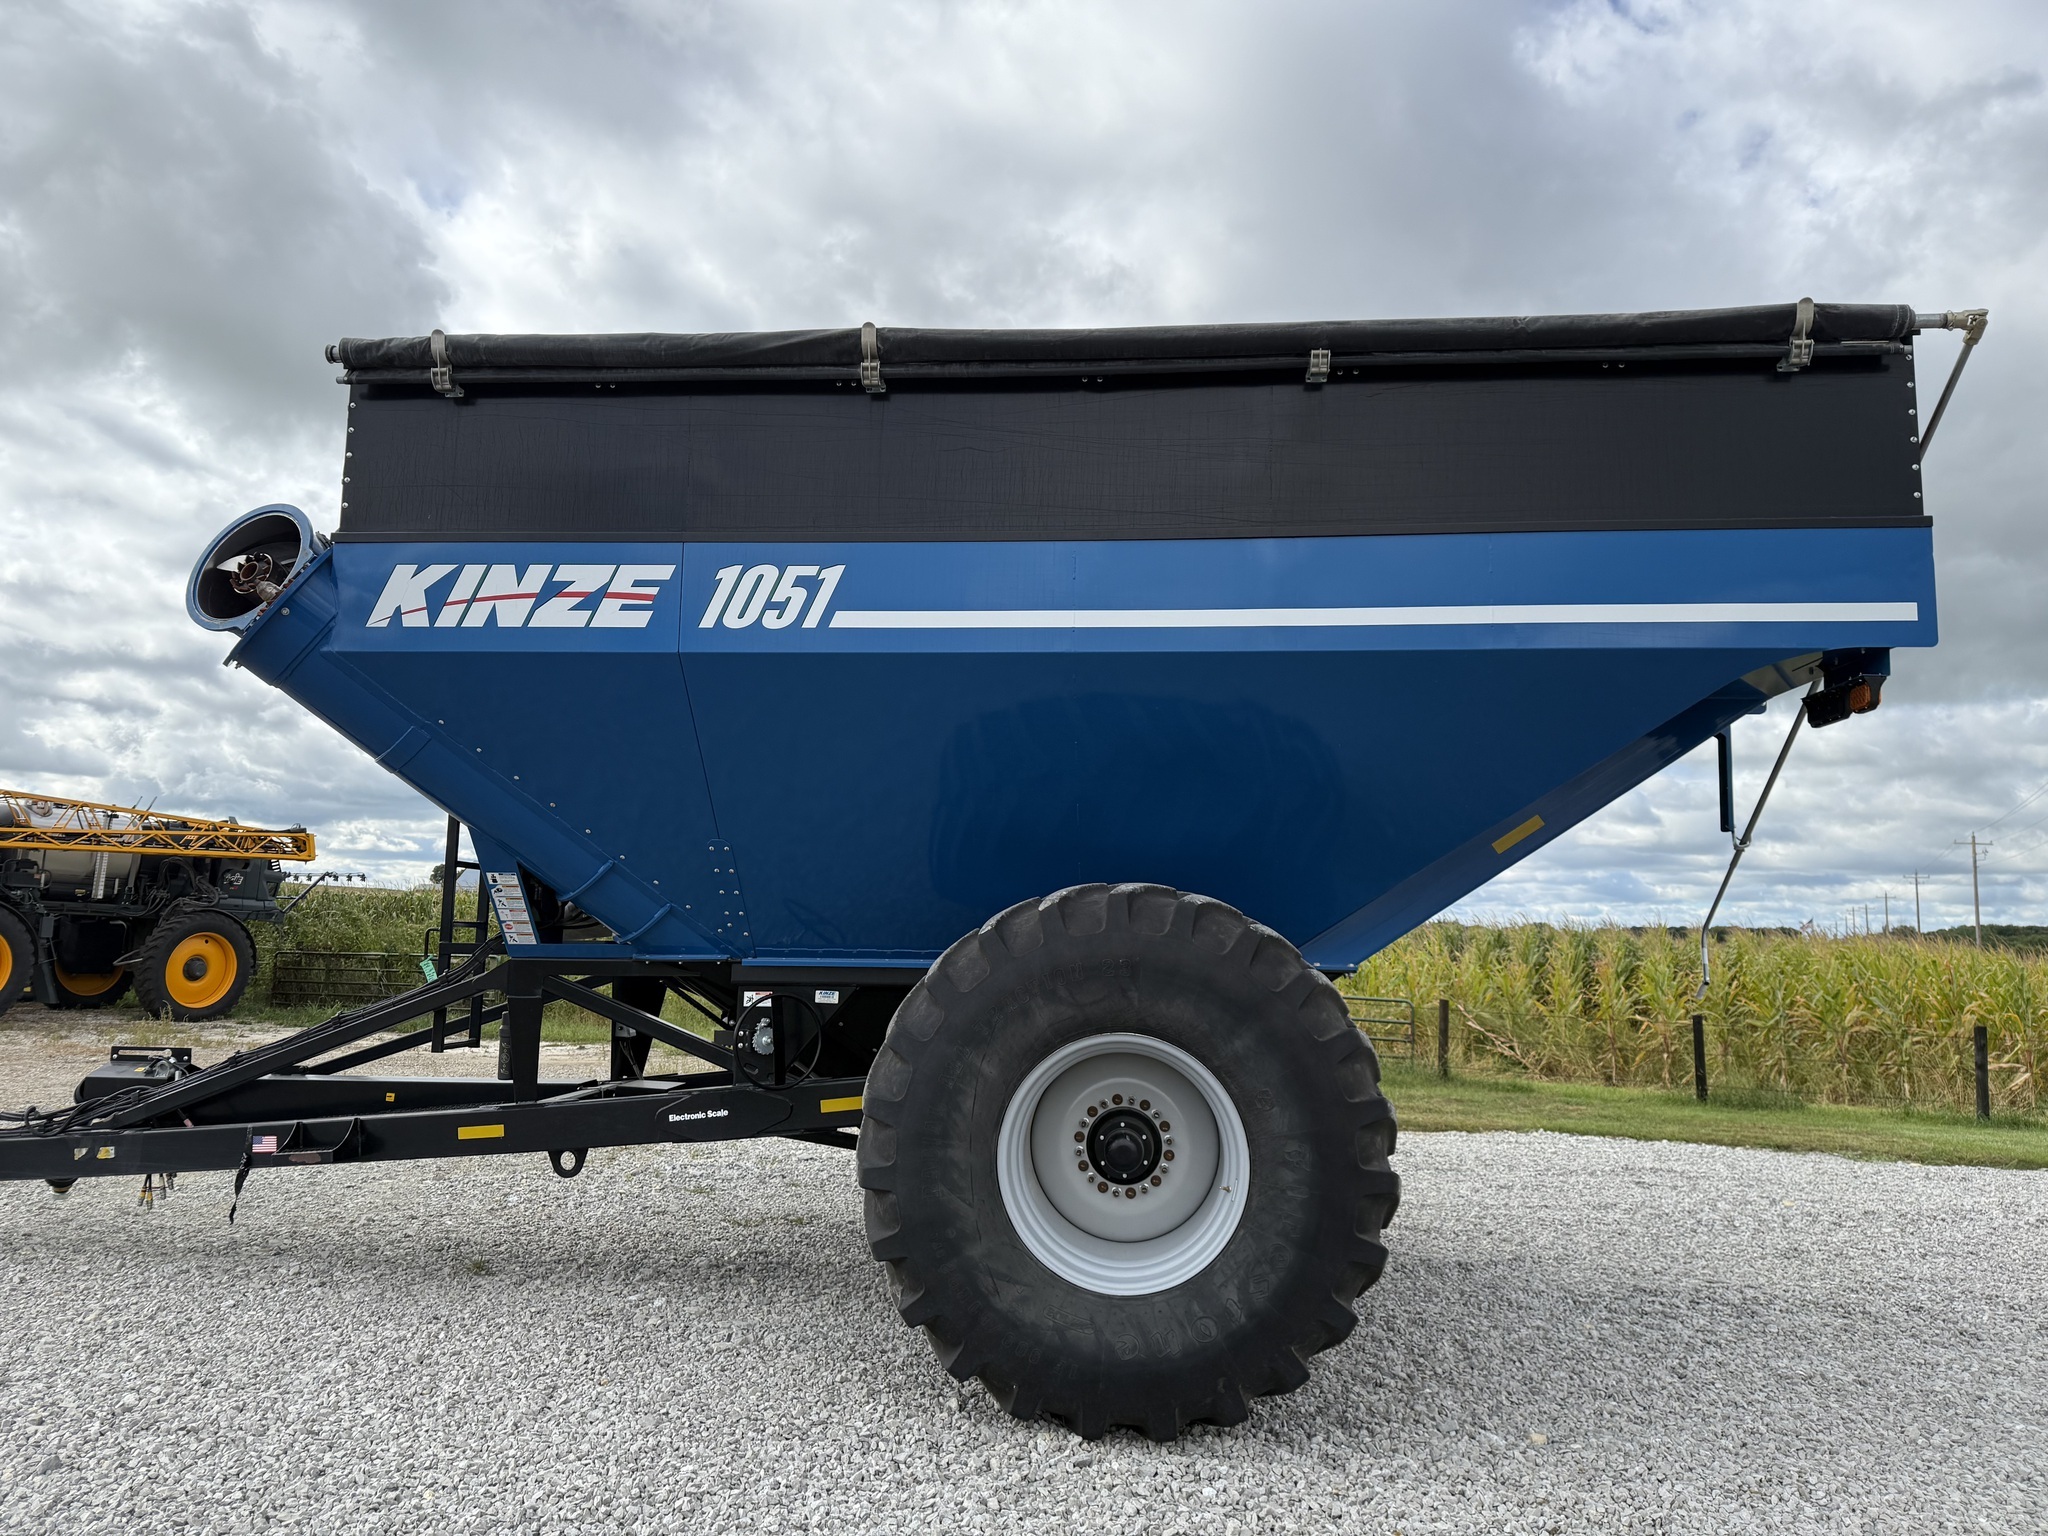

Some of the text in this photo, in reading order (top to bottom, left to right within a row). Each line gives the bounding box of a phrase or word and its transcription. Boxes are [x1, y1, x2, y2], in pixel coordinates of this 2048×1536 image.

[365, 563, 676, 628] KINZE
[699, 563, 846, 629] 1051
[972, 962, 1084, 1035] TRACTION
[669, 1109, 729, 1122] Electronic Scale
